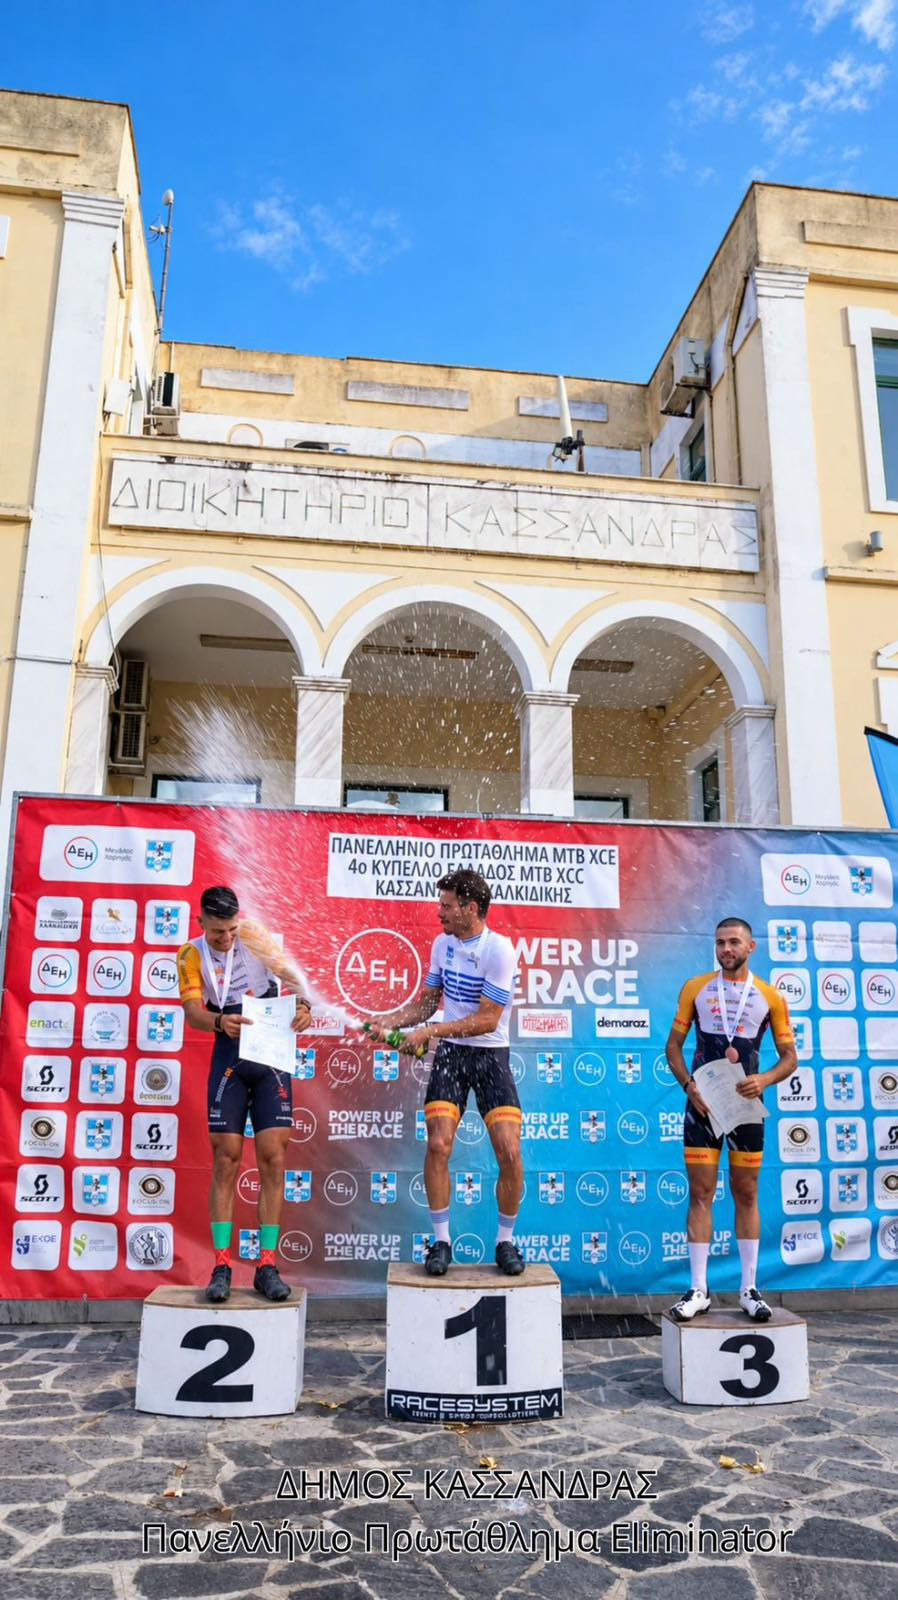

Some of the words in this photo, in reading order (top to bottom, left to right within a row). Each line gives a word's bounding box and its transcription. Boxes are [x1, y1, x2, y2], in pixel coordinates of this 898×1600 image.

[112, 477, 409, 528] ΔΙΟΙΚΗΤΗΡΙΟ
[445, 501, 757, 555] ΚΑΣΣΑΝΔΡΑΣ
[68, 844, 93, 861] ΔΕΗ
[332, 837, 435, 859] ΠΑΝΕΛΛΗΝΙΟ
[440, 842, 548, 863] ΠΡΩΤΑΘΛΗΜΑ
[553, 848, 585, 864] MTB
[590, 849, 616, 866] XCE
[371, 860, 442, 877] ΚΥΠΕΛΛΟ
[521, 866, 552, 882] MTB
[556, 868, 584, 884] XCC
[784, 872, 807, 887] ΔΕΗ
[376, 880, 440, 897] ΚΑΣΣΑΝ
[512, 937, 584, 966] WER
[591, 938, 639, 967] UP
[41, 963, 67, 979] ΔΕΗ
[97, 965, 122, 981] ΔΕΗ
[151, 967, 176, 983] ΔΕΗ
[346, 952, 408, 991] ΔΕΗ
[825, 981, 847, 997] ΔΕΗ
[869, 983, 891, 998] ΔΕΗ
[331, 1058, 356, 1074] ΔΕΗ
[577, 1061, 601, 1076] ΔΕΗ
[25, 1085, 64, 1093] SCOTT
[328, 1110, 381, 1123] POWER
[384, 1111, 404, 1123] UP
[521, 1112, 548, 1125] WER
[551, 1112, 569, 1125] UP
[291, 1118, 312, 1134] ΕΗ
[620, 1119, 645, 1136] ΔΕΗ
[328, 1179, 353, 1195] ΔΕΗ
[580, 1181, 604, 1196] ΔΕΗ
[660, 1180, 685, 1195] ΔΕΗ
[324, 1233, 379, 1246] POWER
[380, 1234, 401, 1246] UP
[511, 1233, 549, 1247] WER
[552, 1234, 571, 1247] UP
[713, 1230, 732, 1243] UP
[282, 1238, 308, 1253] ΔΕΗ
[455, 1242, 481, 1257] ΔΕΗ
[621, 1240, 646, 1256] ΔΕΗ
[444, 1295, 507, 1387] 1
[175, 1324, 256, 1403] 2
[719, 1333, 780, 1399] 3
[390, 1393, 559, 1412] RACESYSTEM
